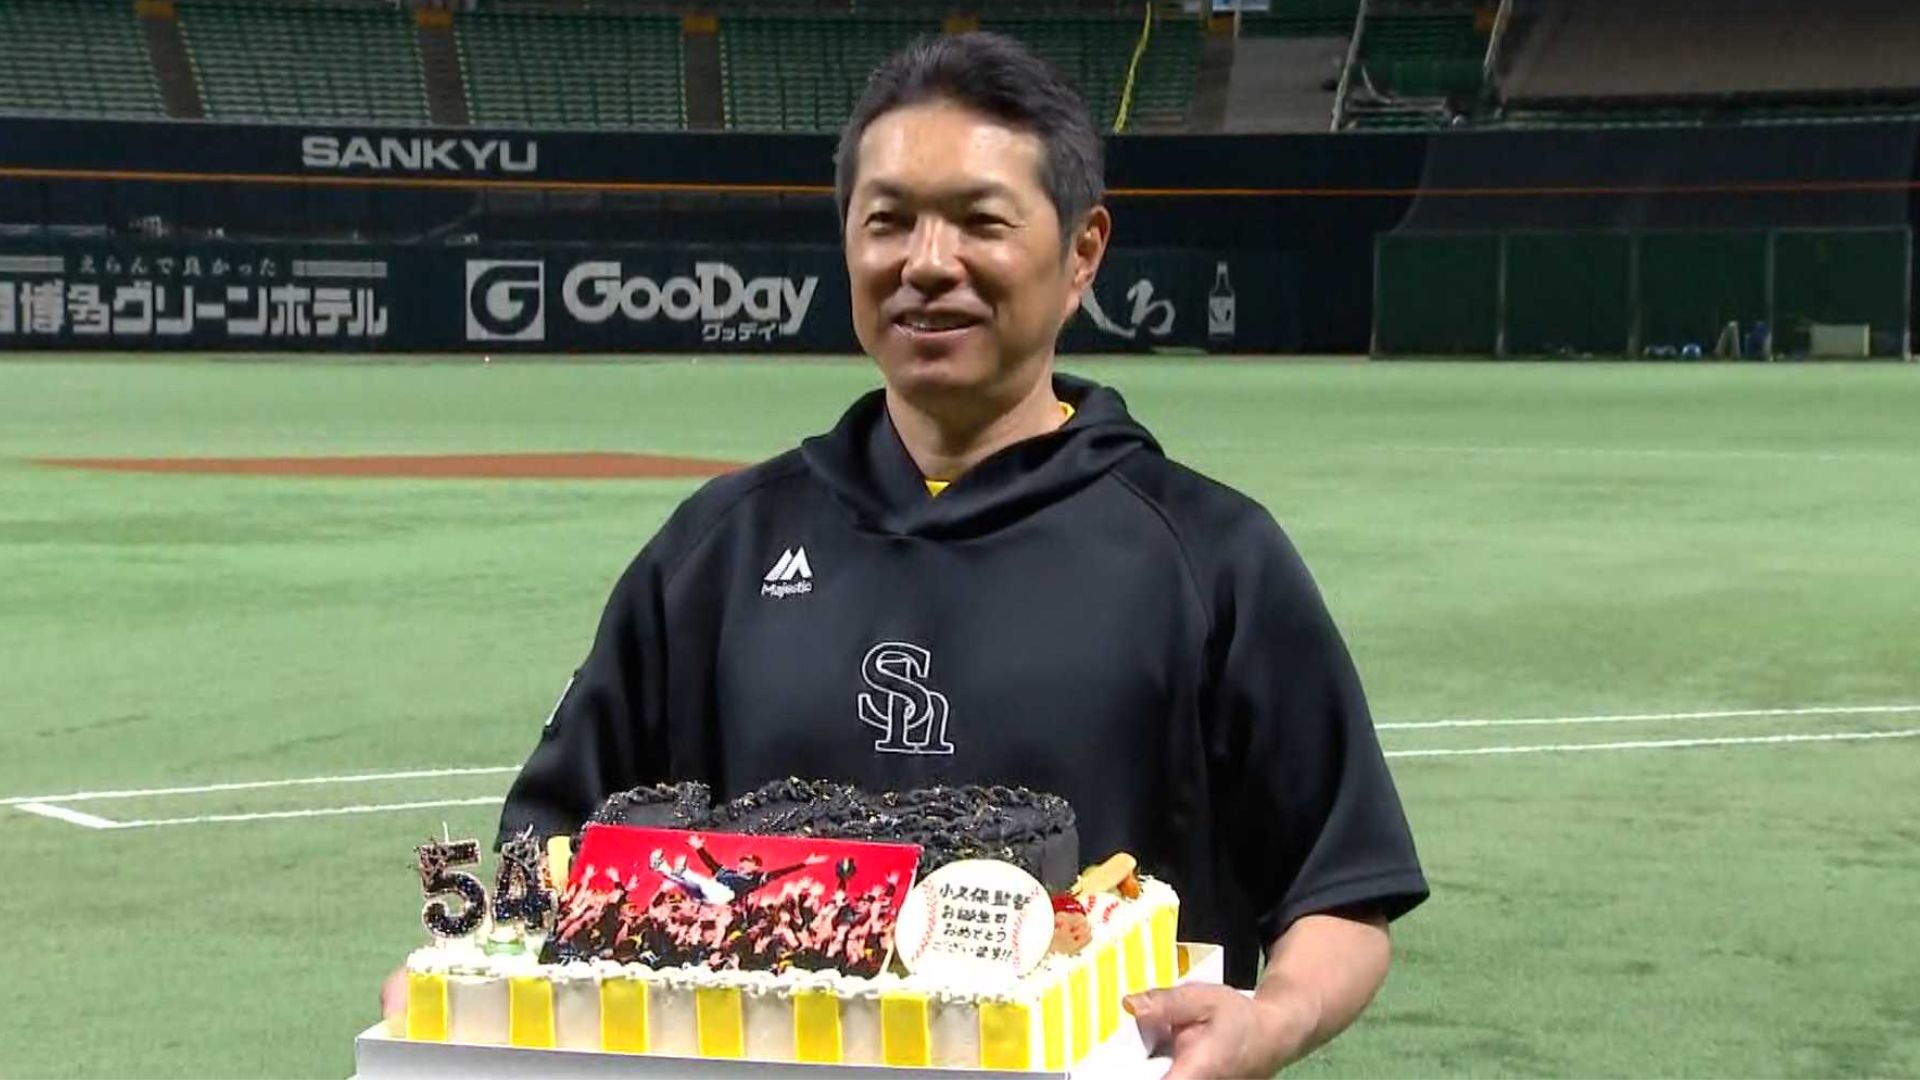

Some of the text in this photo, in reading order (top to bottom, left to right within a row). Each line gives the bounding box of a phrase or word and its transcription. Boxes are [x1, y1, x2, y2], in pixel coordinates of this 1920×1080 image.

[302, 136, 537, 172] SANKYU
[79, 255, 277, 277] えらんで良かった
[20, 279, 388, 335] 博多グリーンホテル
[562, 261, 818, 335] GooDay
[702, 322, 778, 342] グッデイ
[761, 580, 813, 599] Majestic
[418, 837, 559, 939] 54
[943, 923, 1007, 943] おめでとう
